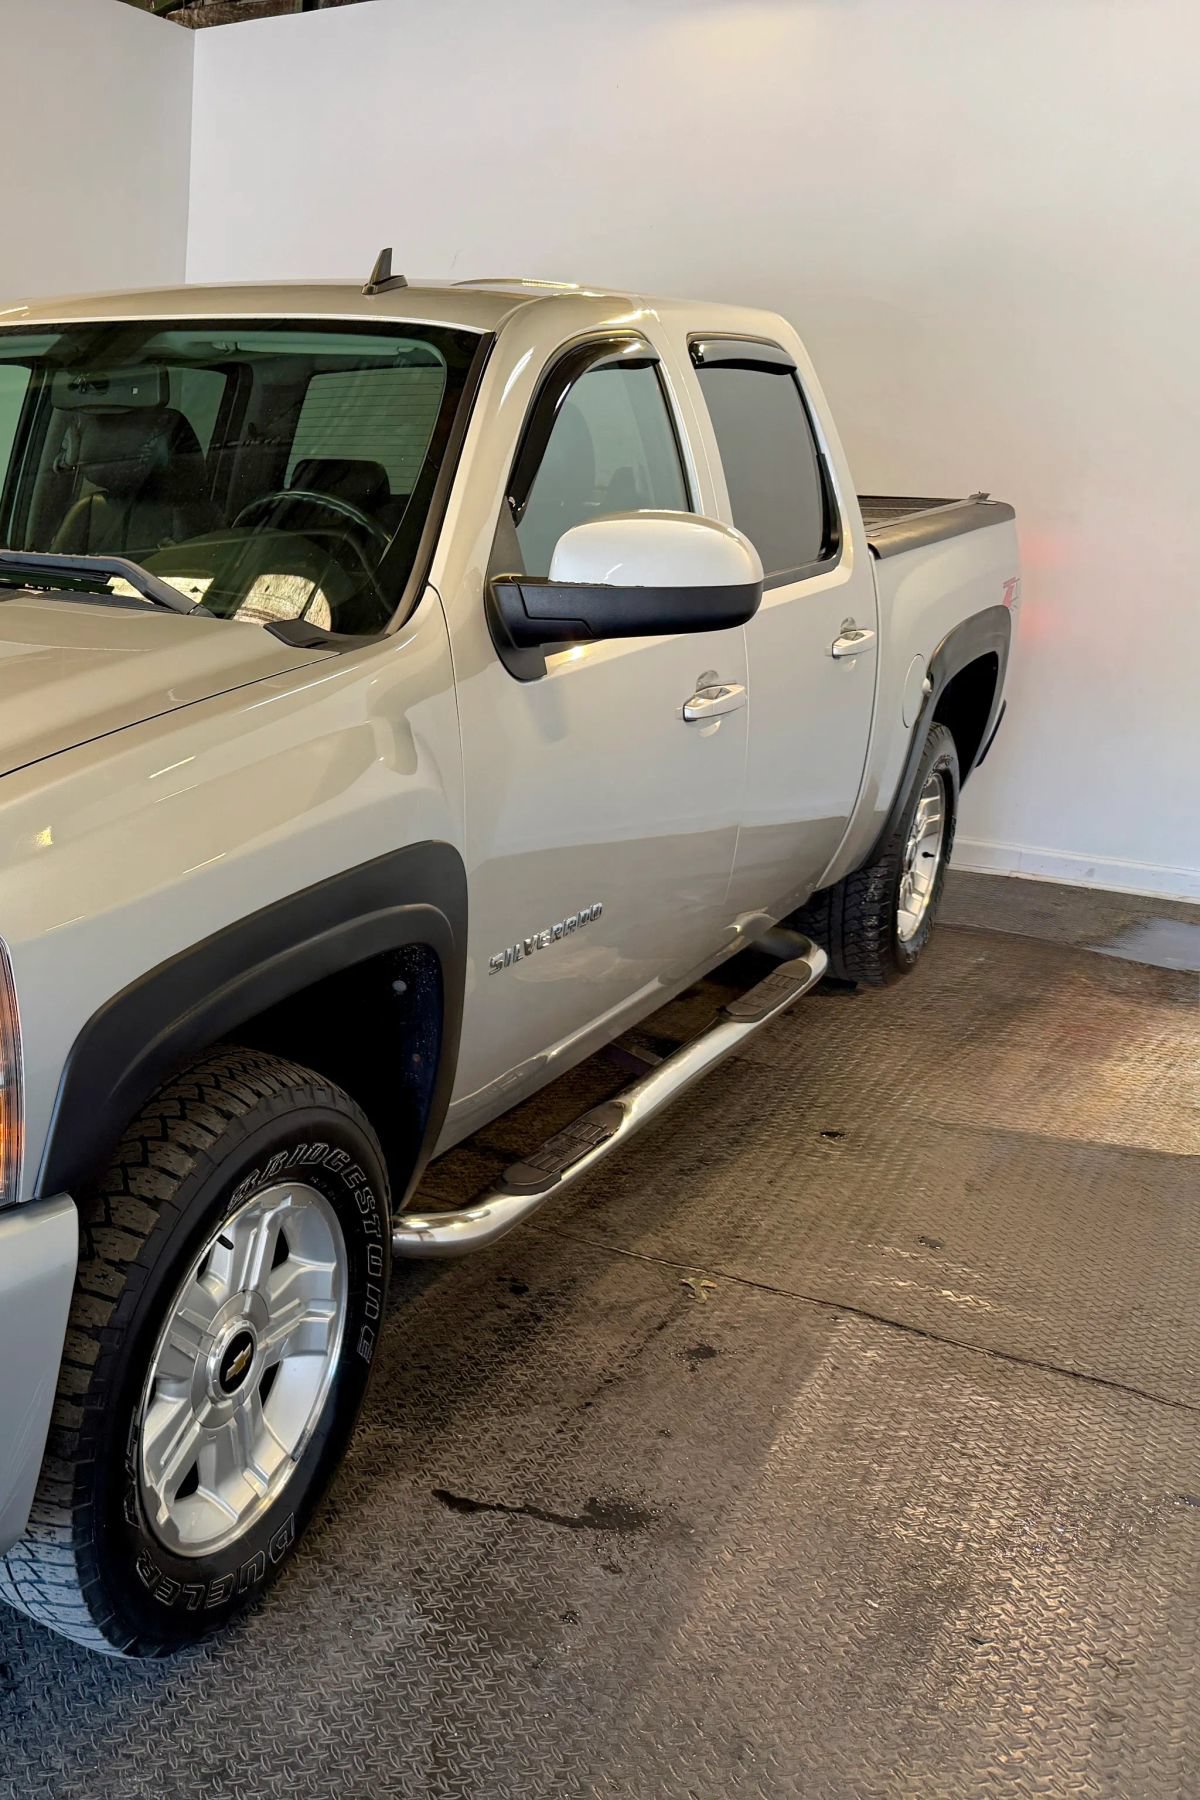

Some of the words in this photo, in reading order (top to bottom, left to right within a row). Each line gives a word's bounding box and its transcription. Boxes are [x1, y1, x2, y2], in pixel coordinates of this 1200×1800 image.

[489, 902, 603, 976] SILVERADO
[227, 1141, 384, 1364] BRIDGESTONE
[135, 1512, 296, 1612] DUELER
